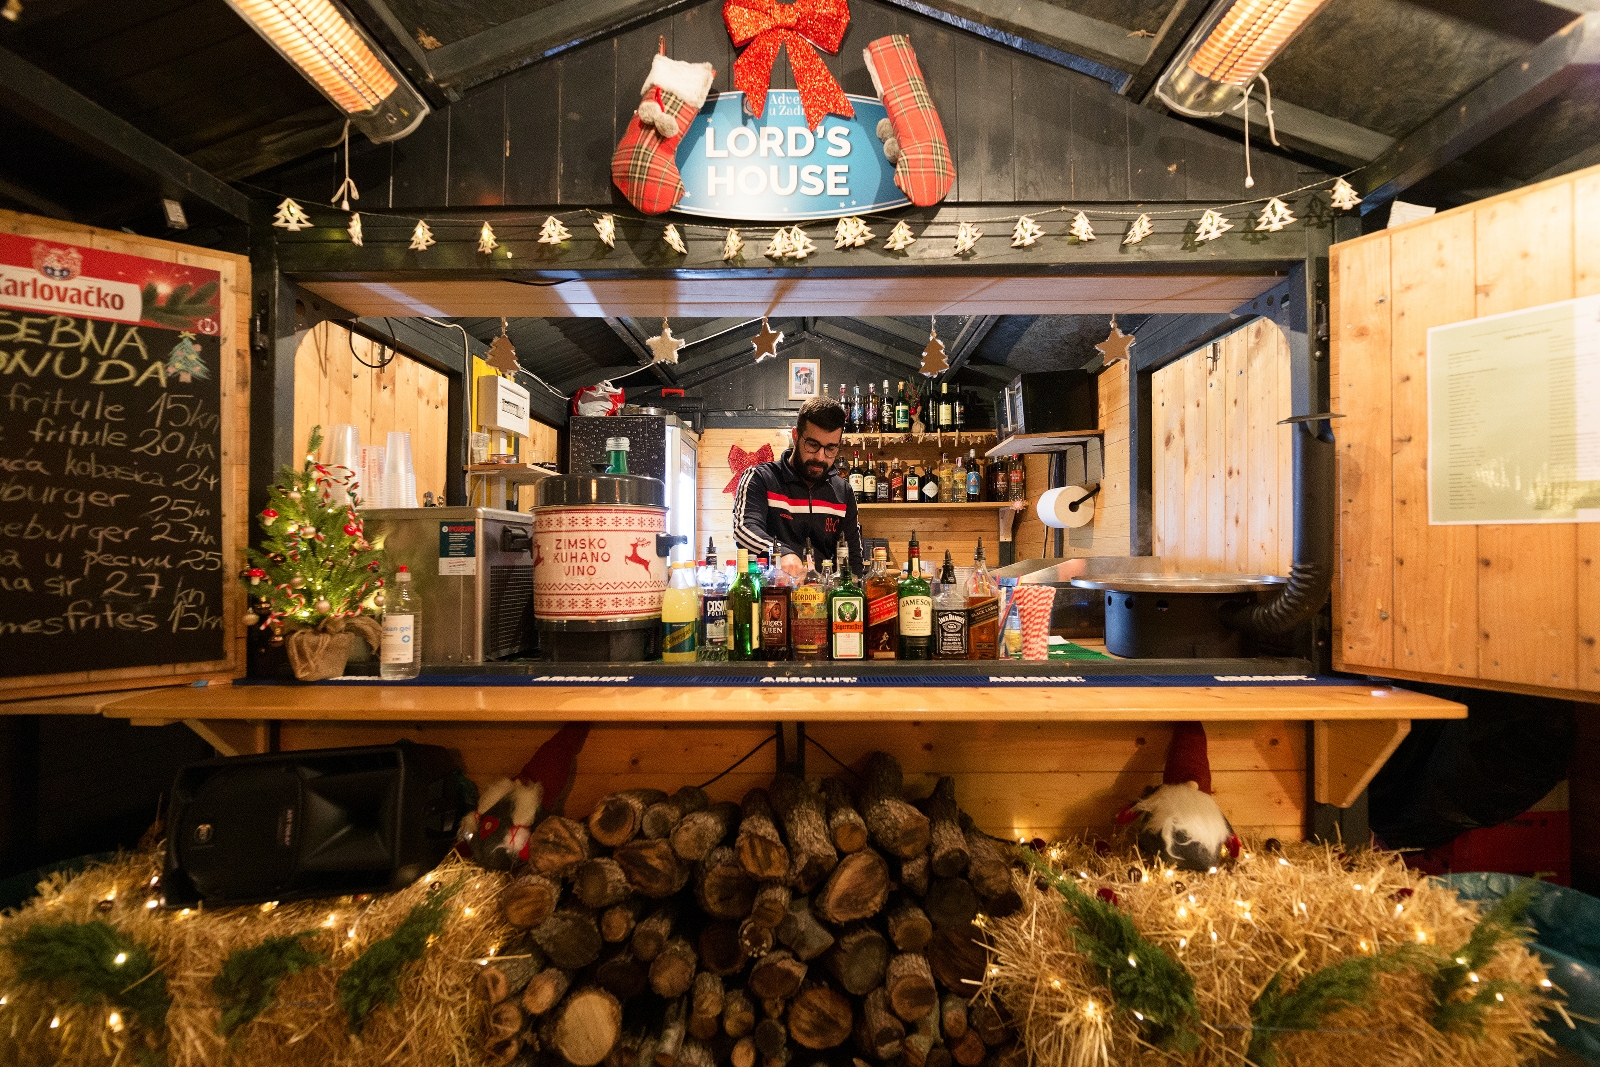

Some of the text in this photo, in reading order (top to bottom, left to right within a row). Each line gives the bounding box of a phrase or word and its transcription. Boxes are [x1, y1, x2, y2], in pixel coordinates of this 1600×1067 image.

[769, 93, 802, 105] Adve
[769, 107, 776, 116] u
[705, 126, 851, 158] LORD'S
[707, 164, 850, 196] HOUSE
[0, 272, 124, 311] arlovačko
[28, 417, 128, 447] fritule
[555, 538, 607, 550] ZIMSKO
[553, 552, 611, 563] KUHANO
